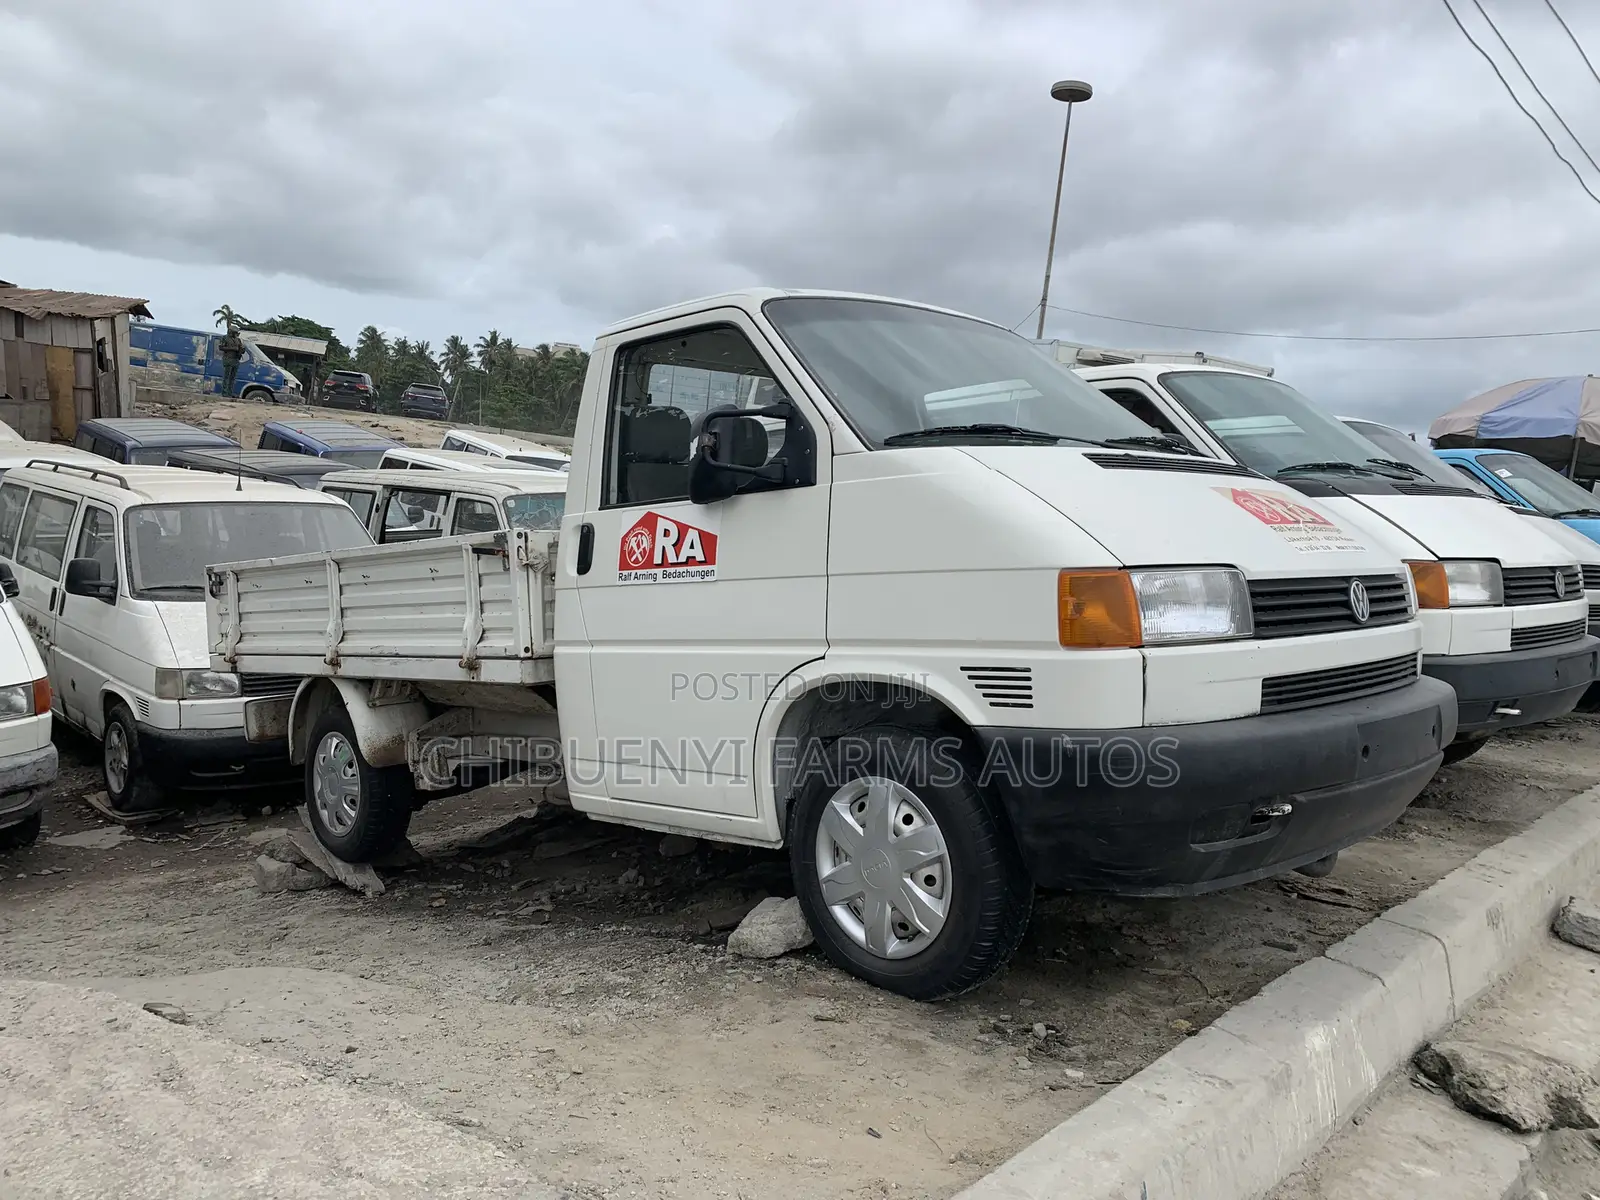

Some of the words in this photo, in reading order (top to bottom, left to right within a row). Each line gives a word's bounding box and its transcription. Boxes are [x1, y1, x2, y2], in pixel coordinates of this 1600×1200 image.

[653, 516, 707, 566] RA
[619, 572, 632, 581] Ralf
[633, 571, 658, 582] Arning
[662, 569, 715, 579] Bedachungen
